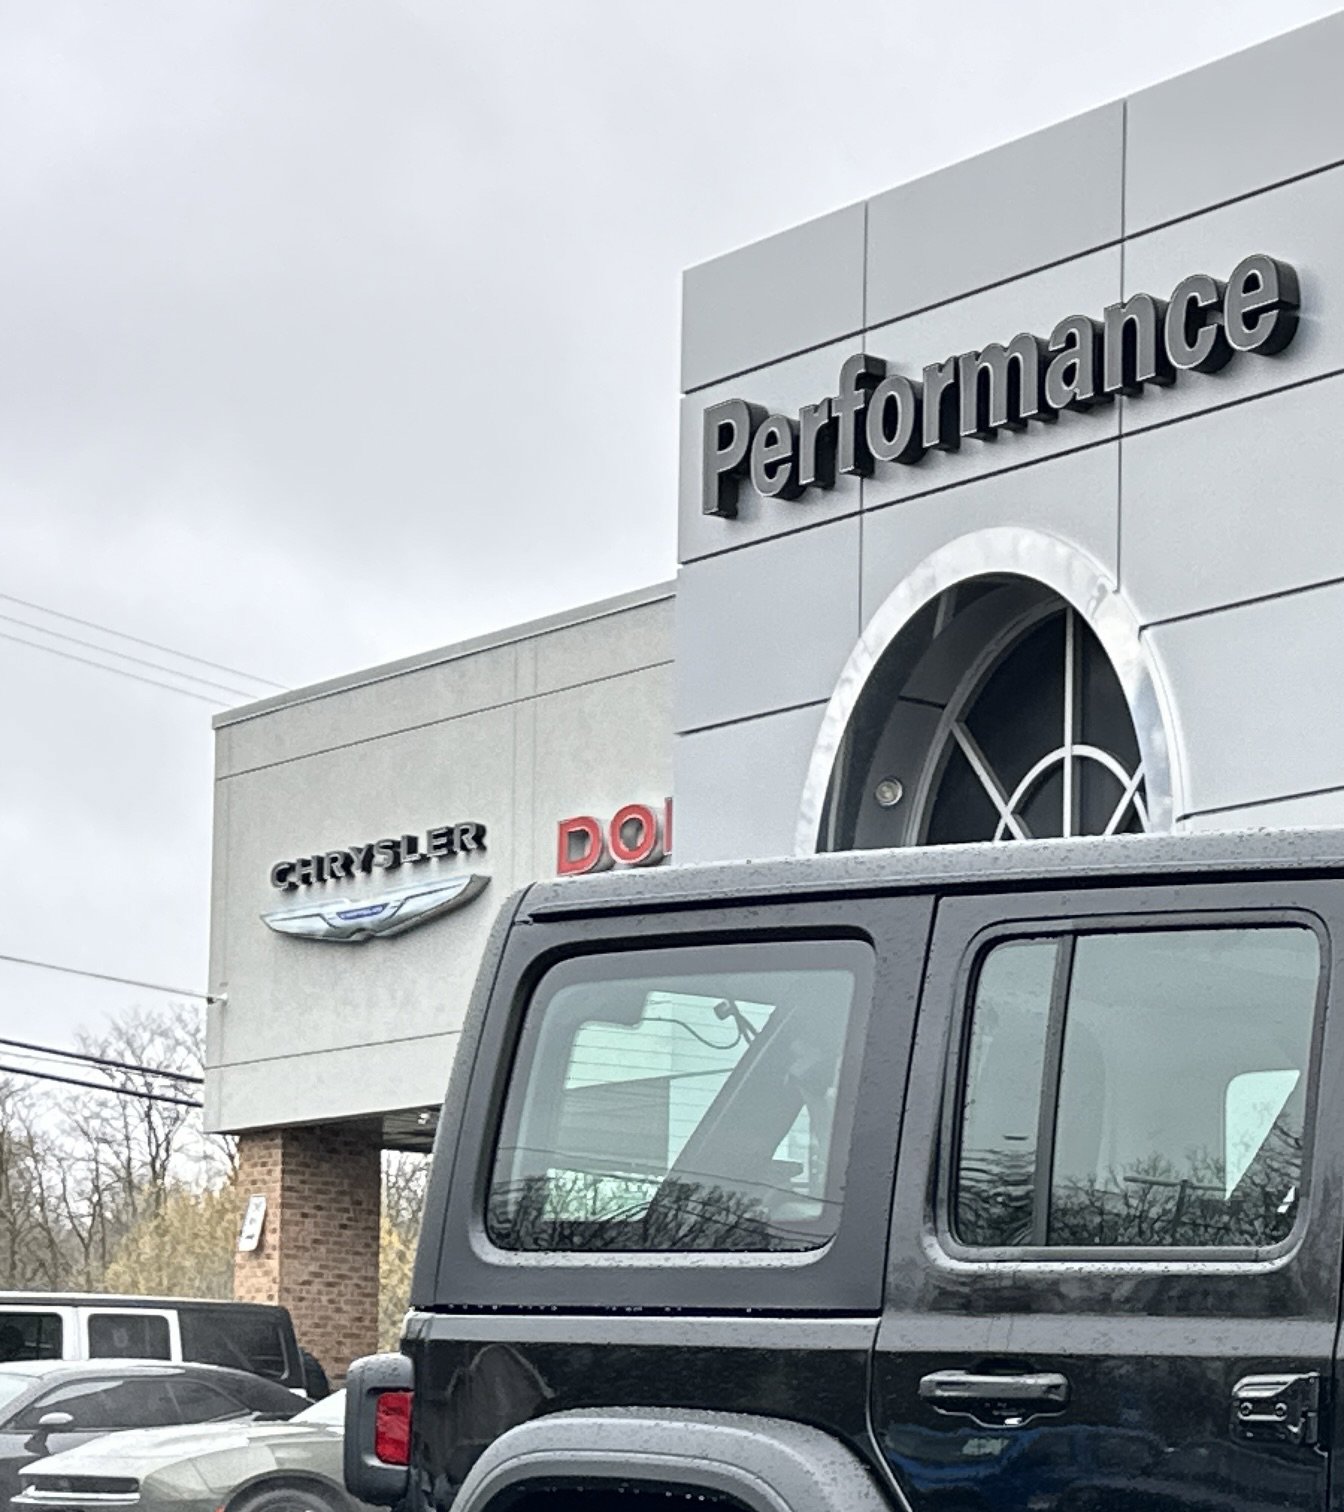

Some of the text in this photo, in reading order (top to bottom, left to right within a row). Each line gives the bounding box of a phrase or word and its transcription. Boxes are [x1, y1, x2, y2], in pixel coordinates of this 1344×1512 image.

[702, 253, 1300, 518] Performance
[269, 821, 487, 891] CHRYSLER
[556, 796, 673, 875] DO
